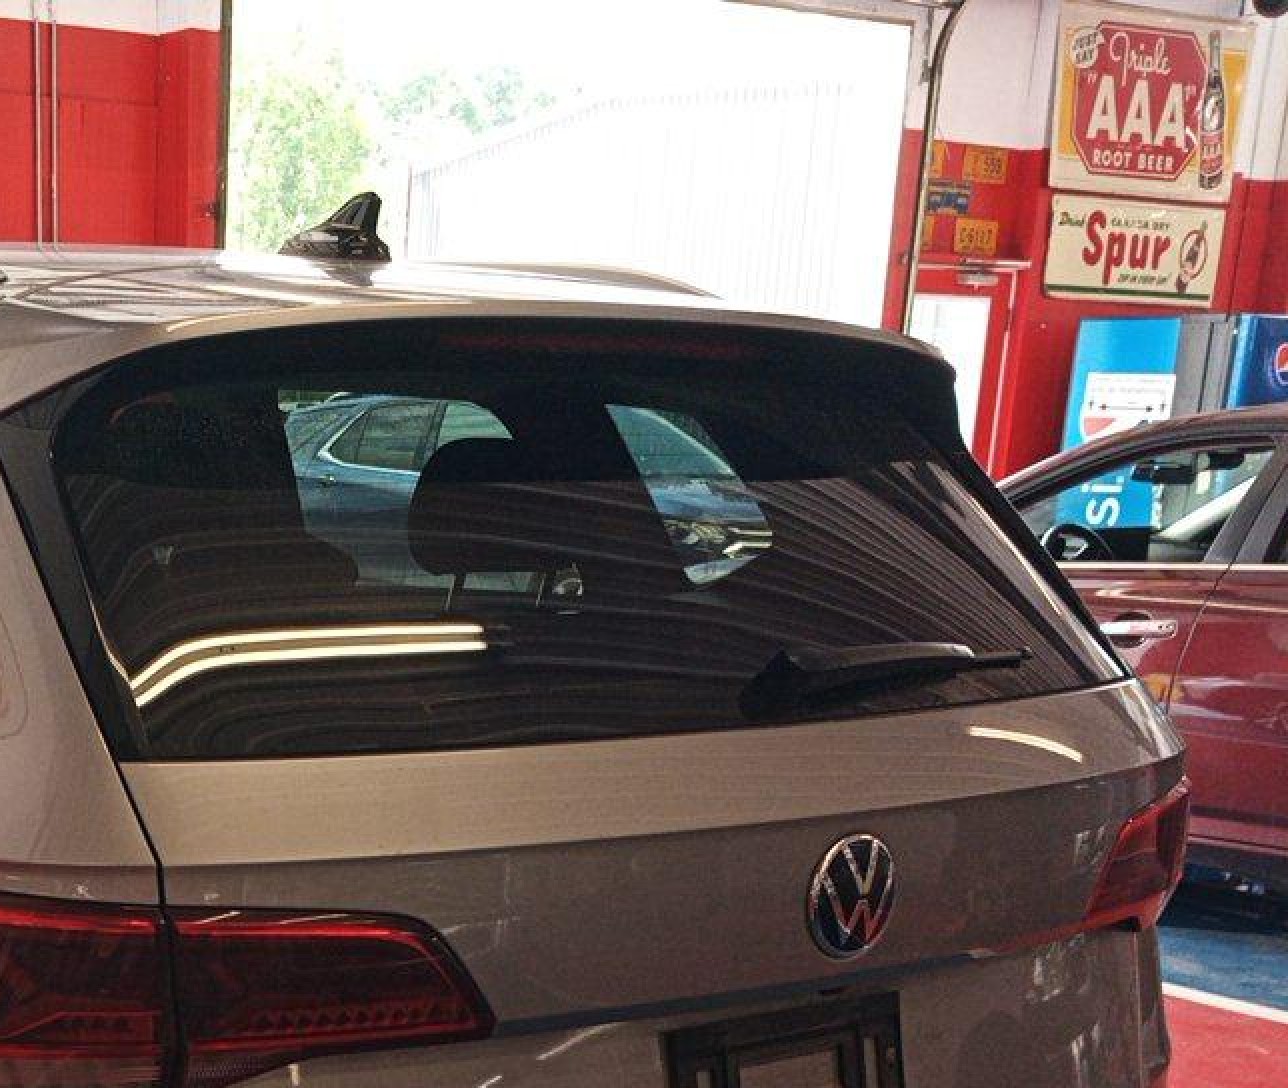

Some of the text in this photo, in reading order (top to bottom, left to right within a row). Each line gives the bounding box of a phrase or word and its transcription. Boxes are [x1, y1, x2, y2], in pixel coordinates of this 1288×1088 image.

[1109, 32, 1171, 87] Triple
[1092, 149, 1175, 173] ROOT BEER
[1081, 209, 1172, 286] Spur
